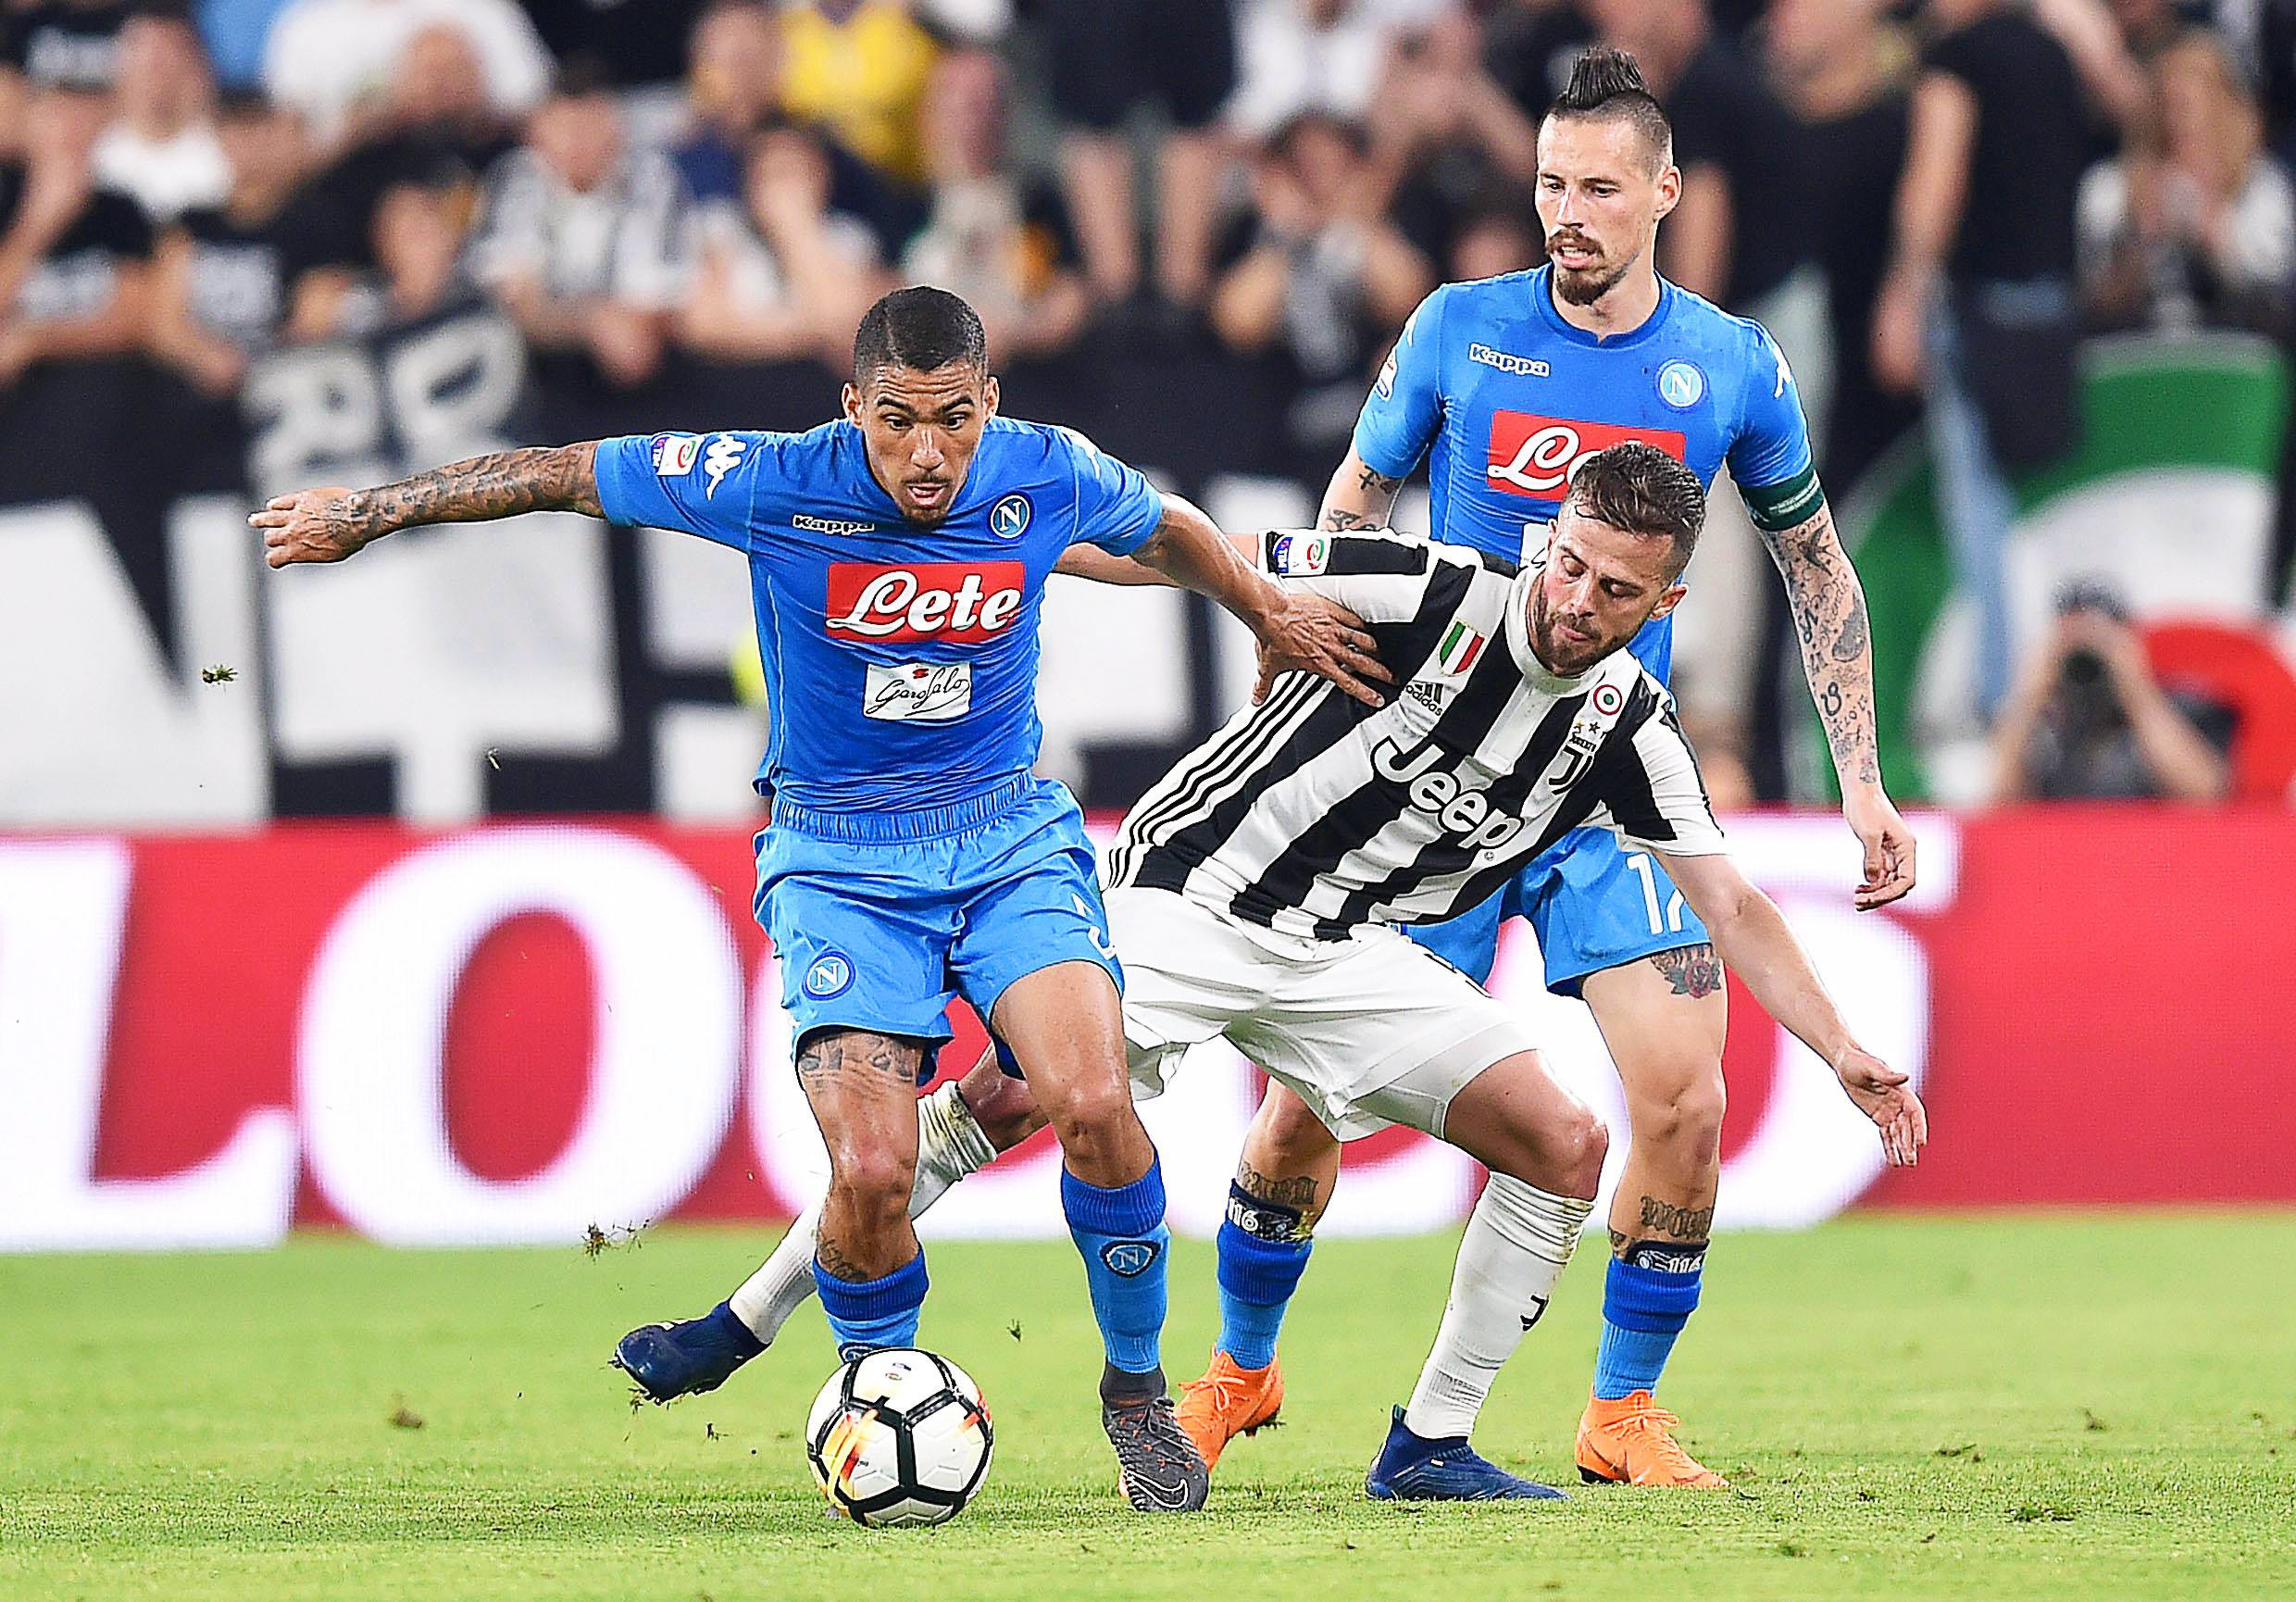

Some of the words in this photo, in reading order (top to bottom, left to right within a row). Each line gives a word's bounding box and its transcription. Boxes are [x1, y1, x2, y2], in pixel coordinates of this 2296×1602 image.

[1469, 343, 1550, 377] Kappa
[792, 514, 875, 535] Kappa
[826, 570, 1022, 636] Lete
[866, 668, 969, 716] Garofalo
[1406, 685, 1442, 716] adidas
[1372, 737, 1525, 849] Jeep
